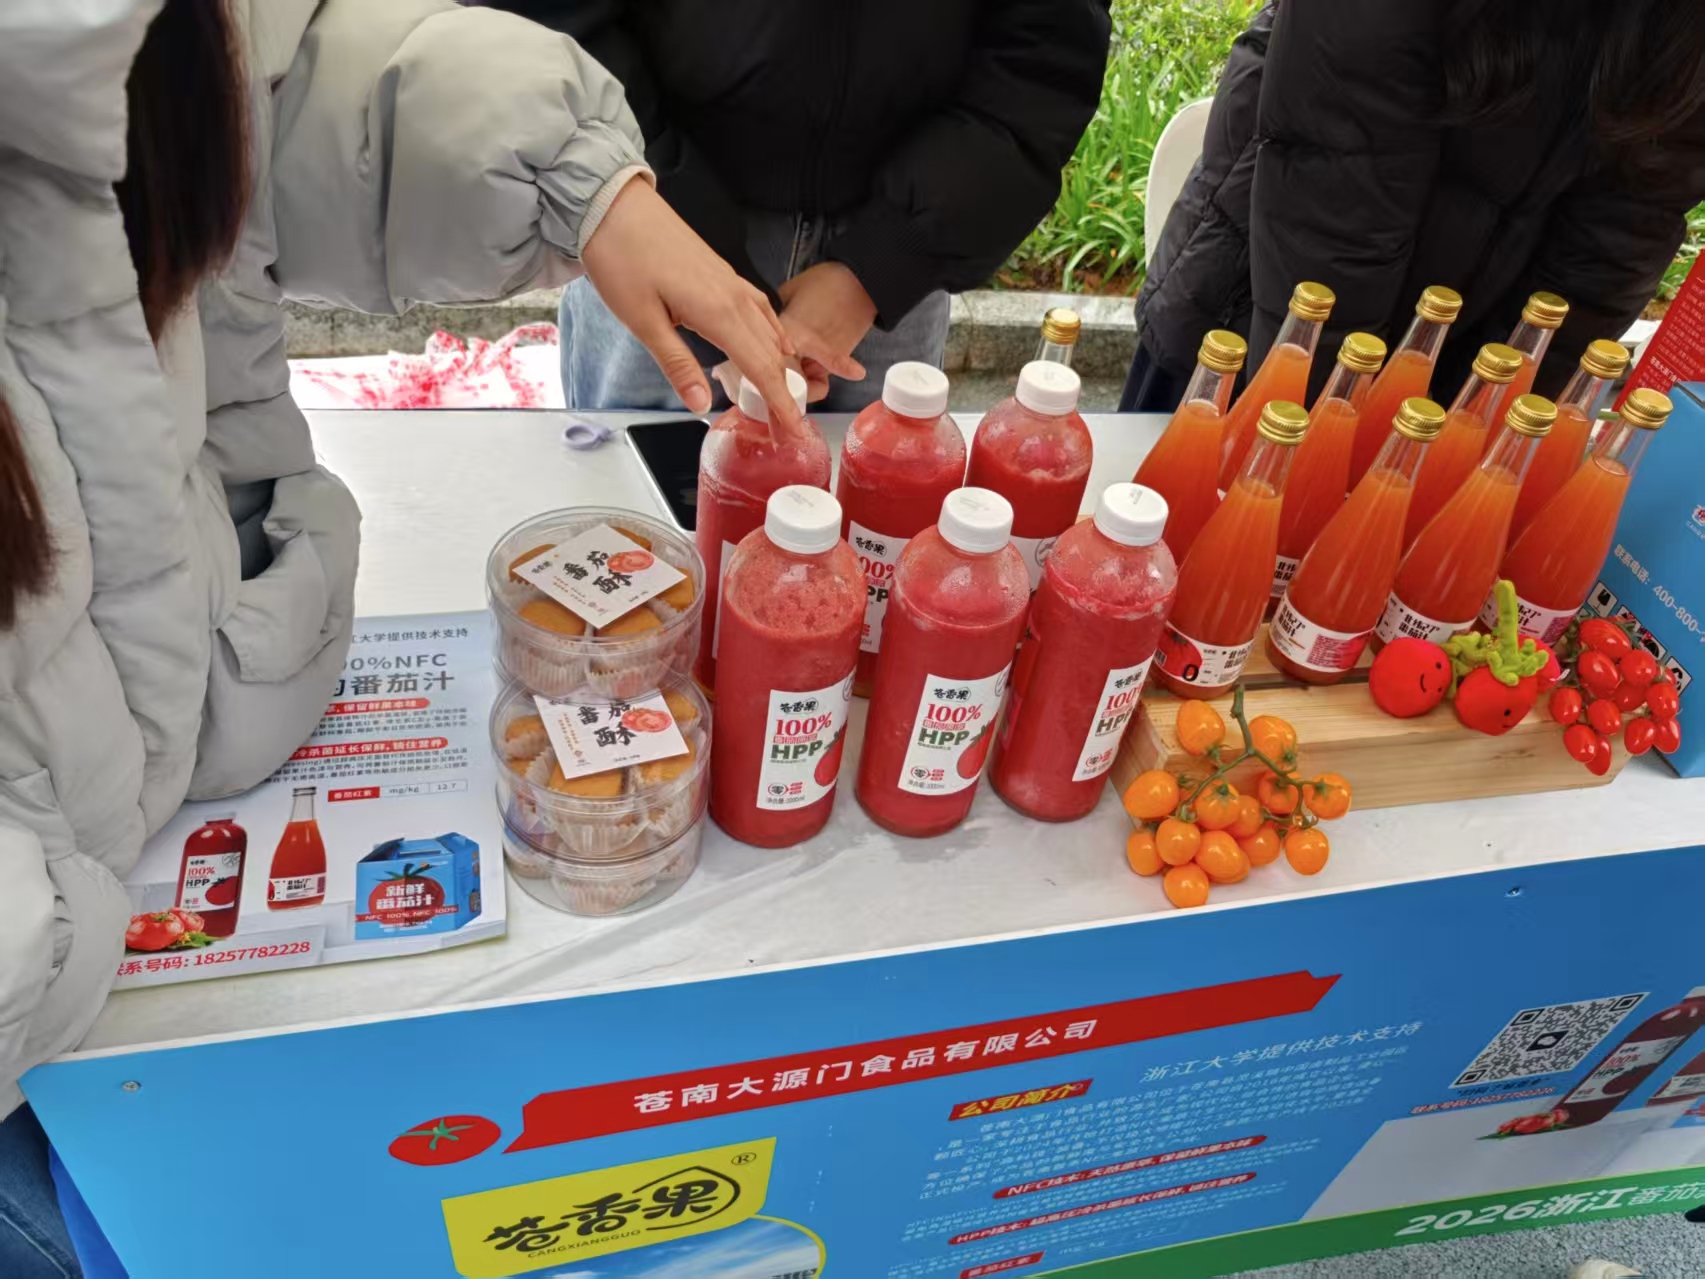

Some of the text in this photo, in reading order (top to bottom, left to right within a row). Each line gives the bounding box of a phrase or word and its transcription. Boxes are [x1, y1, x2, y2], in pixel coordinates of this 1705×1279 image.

[859, 556, 895, 580] 00%
[868, 585, 889, 603] PP
[343, 653, 447, 671] 0%NFC
[779, 698, 819, 714] 苍香果
[934, 687, 971, 702] 苍香果
[776, 712, 833, 737] 100%
[925, 704, 983, 723] 100%
[918, 727, 970, 746] HPP
[771, 740, 823, 760] HPP
[185, 878, 210, 888] HPP
[193, 941, 311, 967] 18257782228
[1139, 1021, 1424, 1084] 浙江大学提供技术支持
[634, 1019, 1098, 1115] 苍南大源门食品有限公司
[958, 1084, 1077, 1118] 公司简介
[483, 1170, 735, 1253] 苍香果
[1395, 1181, 1705, 1236] 2026浙江番茄
[527, 1228, 641, 1258] CANGXIANGGUO
